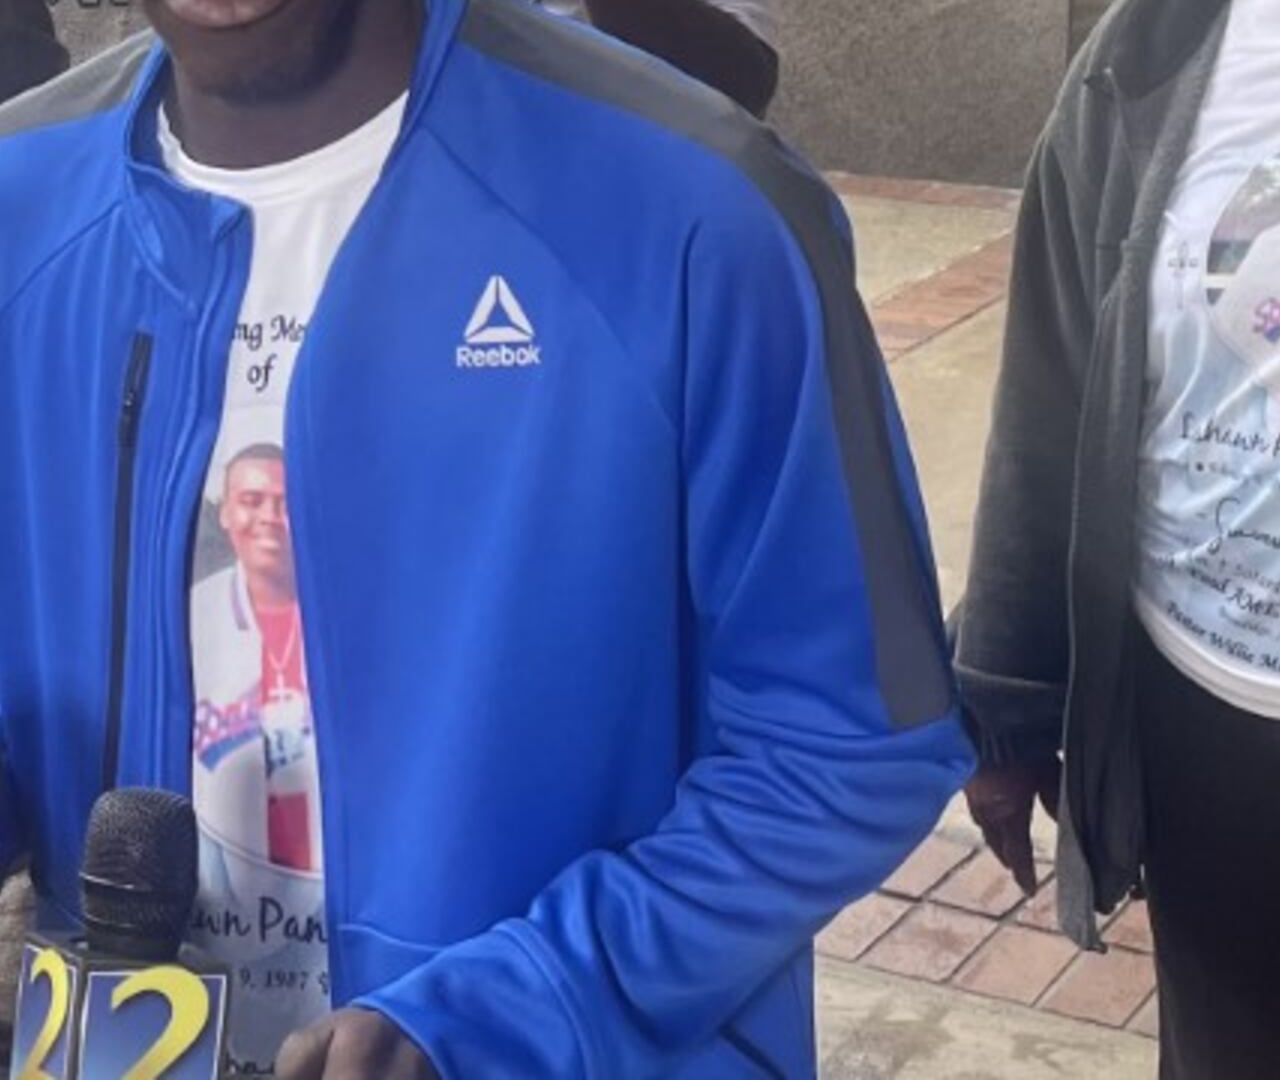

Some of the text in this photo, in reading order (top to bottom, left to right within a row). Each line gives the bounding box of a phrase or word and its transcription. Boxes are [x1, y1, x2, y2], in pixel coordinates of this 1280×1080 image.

[246, 352, 278, 394] of
[456, 344, 541, 369] Reebok
[17, 946, 72, 1080] 2
[111, 965, 210, 1080] 2
